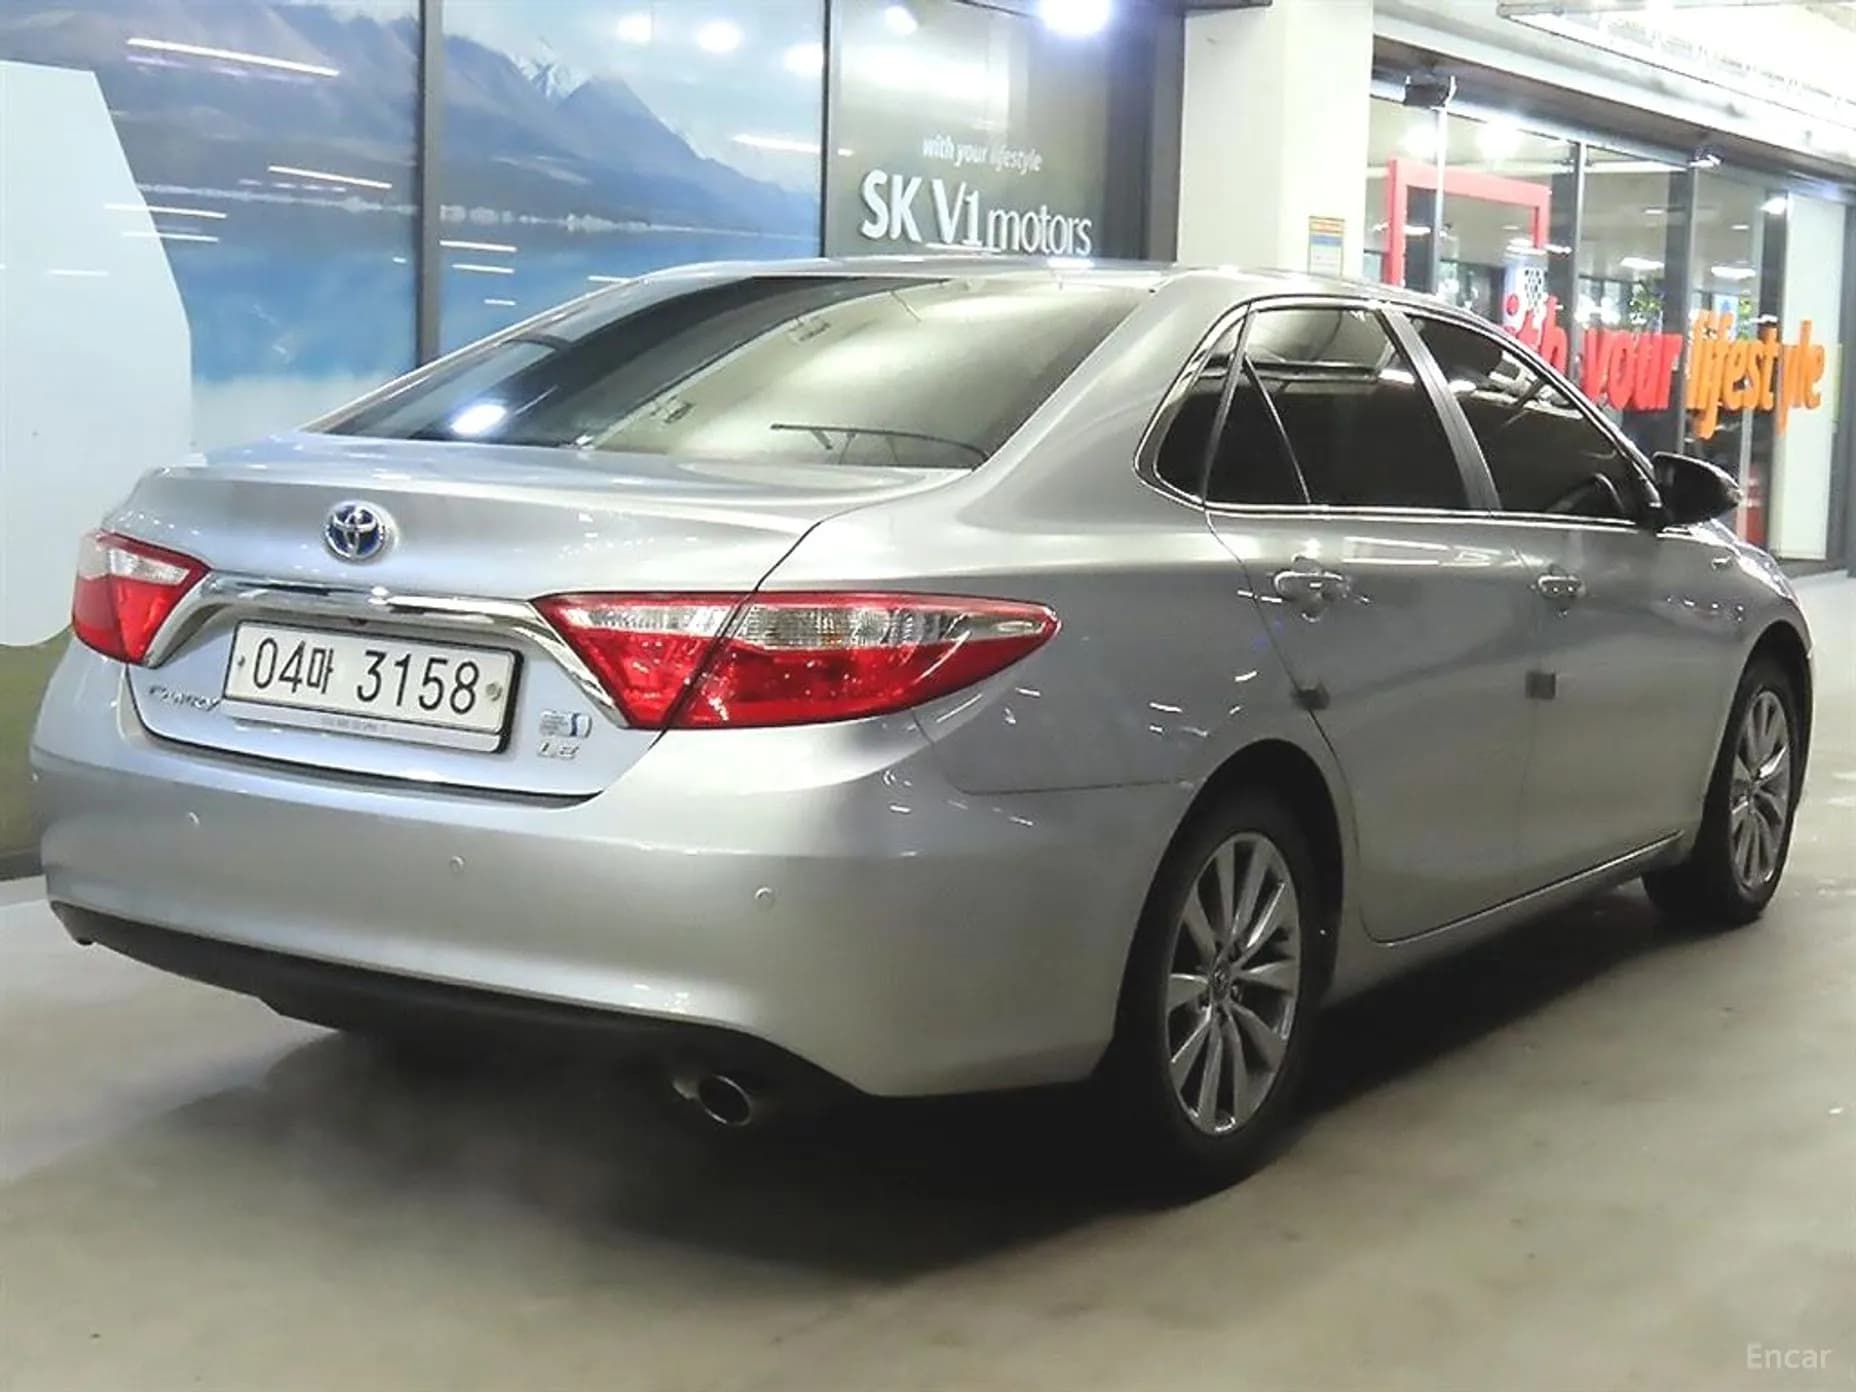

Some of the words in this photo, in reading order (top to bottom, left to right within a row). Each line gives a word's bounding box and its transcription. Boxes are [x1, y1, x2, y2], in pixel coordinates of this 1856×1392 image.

[922, 133, 955, 161] with
[954, 143, 989, 168] your
[861, 169, 923, 243] SK
[931, 179, 983, 247] V1
[985, 203, 1093, 256] motors
[1582, 326, 1684, 412] your
[253, 636, 334, 696] 04마
[356, 649, 480, 715] 3158
